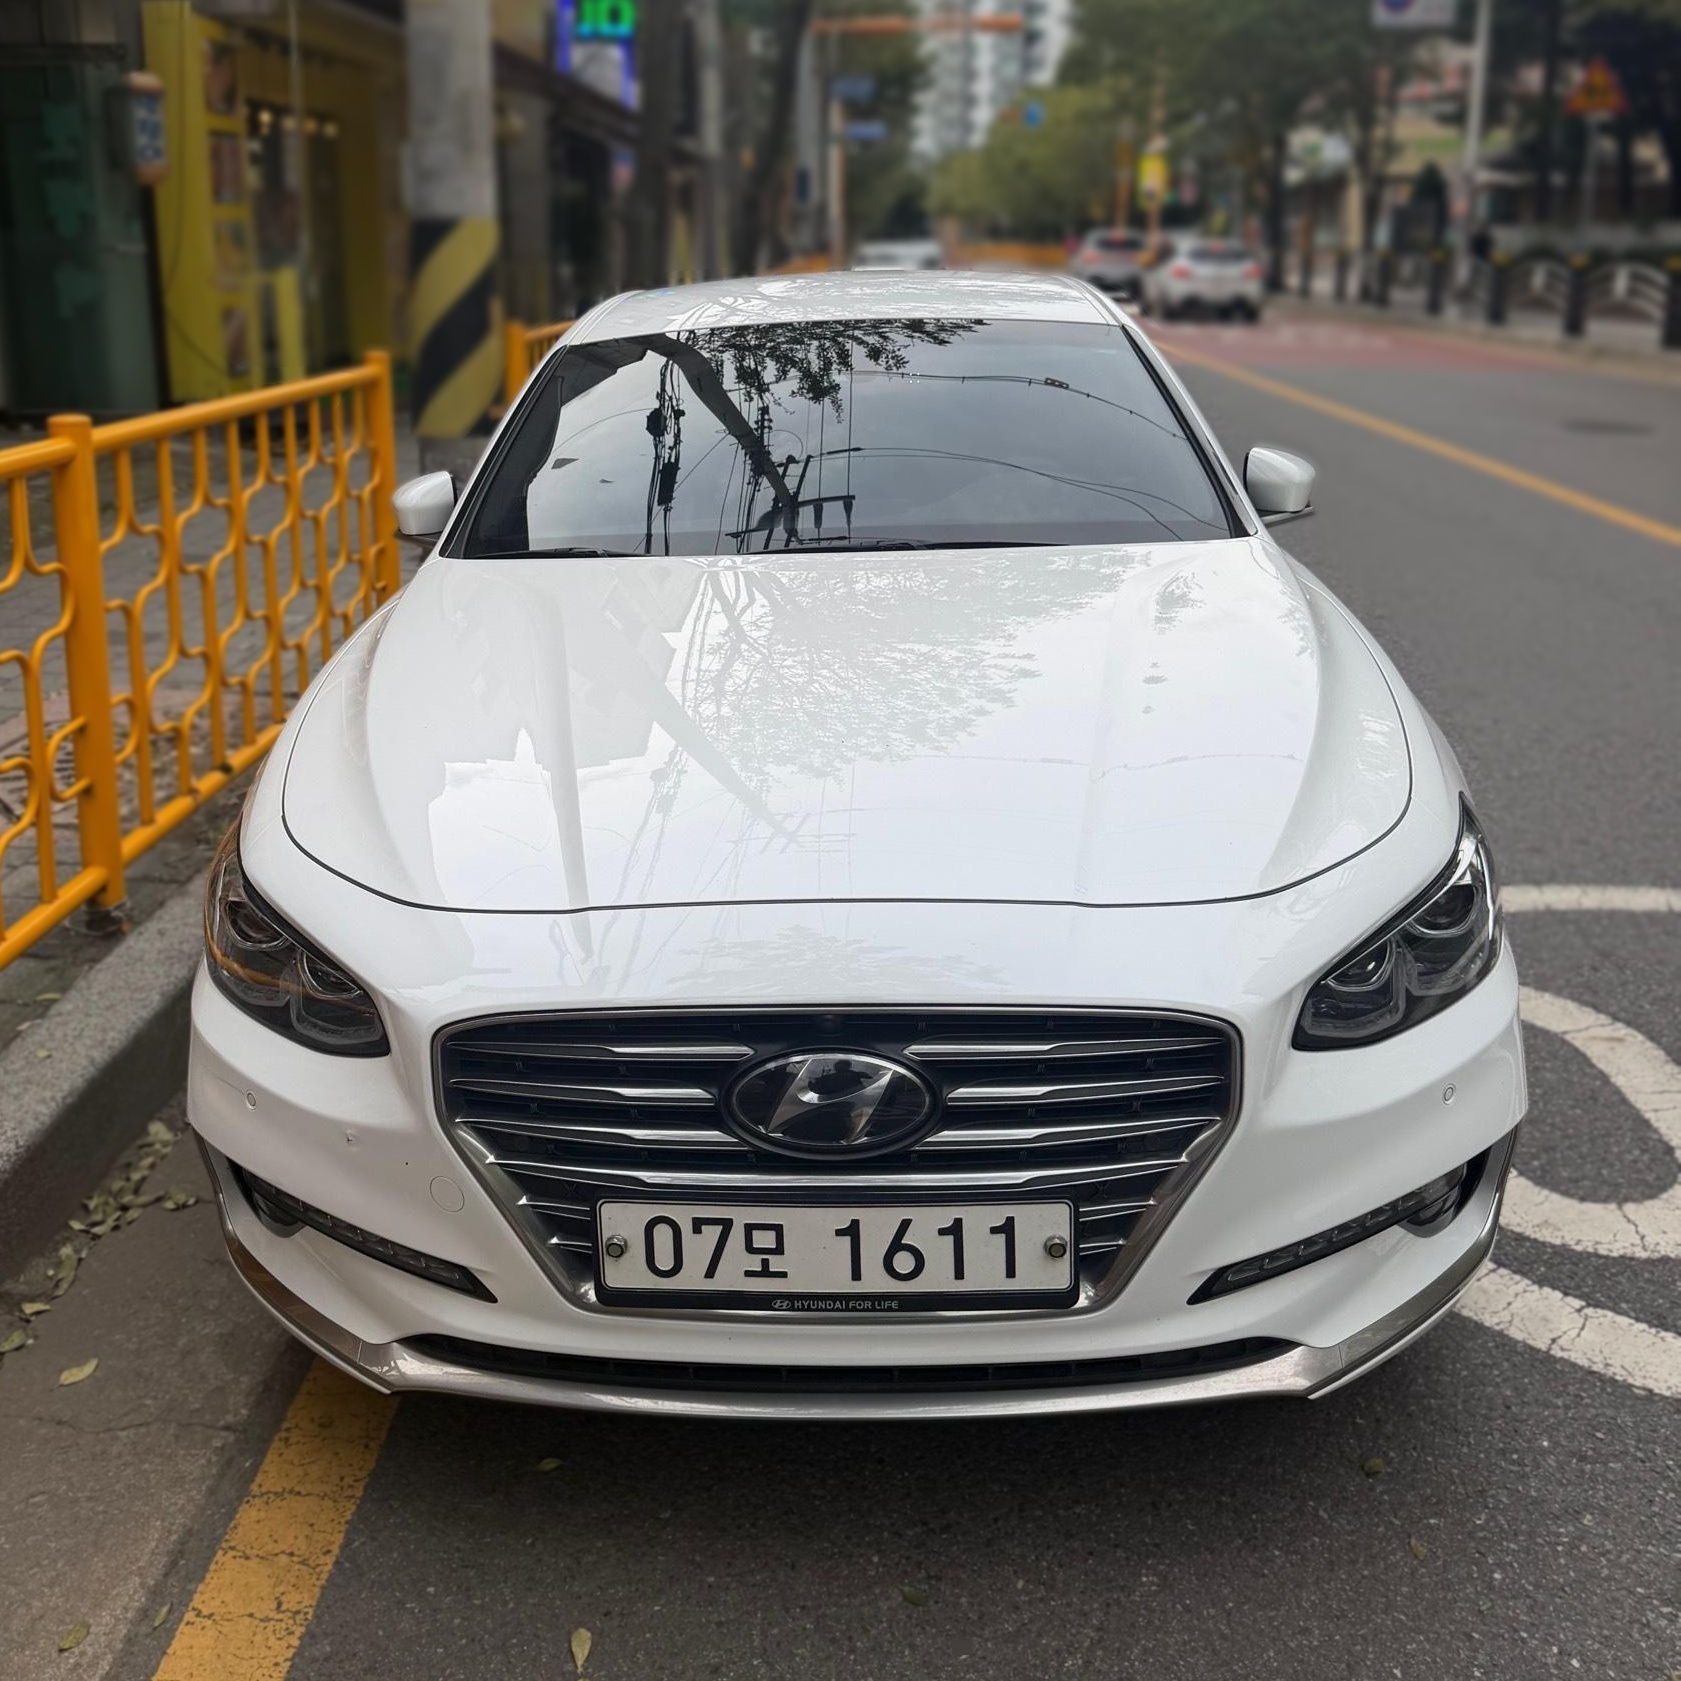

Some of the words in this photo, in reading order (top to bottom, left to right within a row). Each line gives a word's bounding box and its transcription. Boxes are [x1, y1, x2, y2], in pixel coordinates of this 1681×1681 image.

[644, 1215, 788, 1280] 07모
[834, 1215, 1017, 1282] 1611
[794, 1300, 846, 1310] HYUNDAI
[848, 1300, 872, 1310] FOR
[874, 1300, 899, 1310] LIFE
